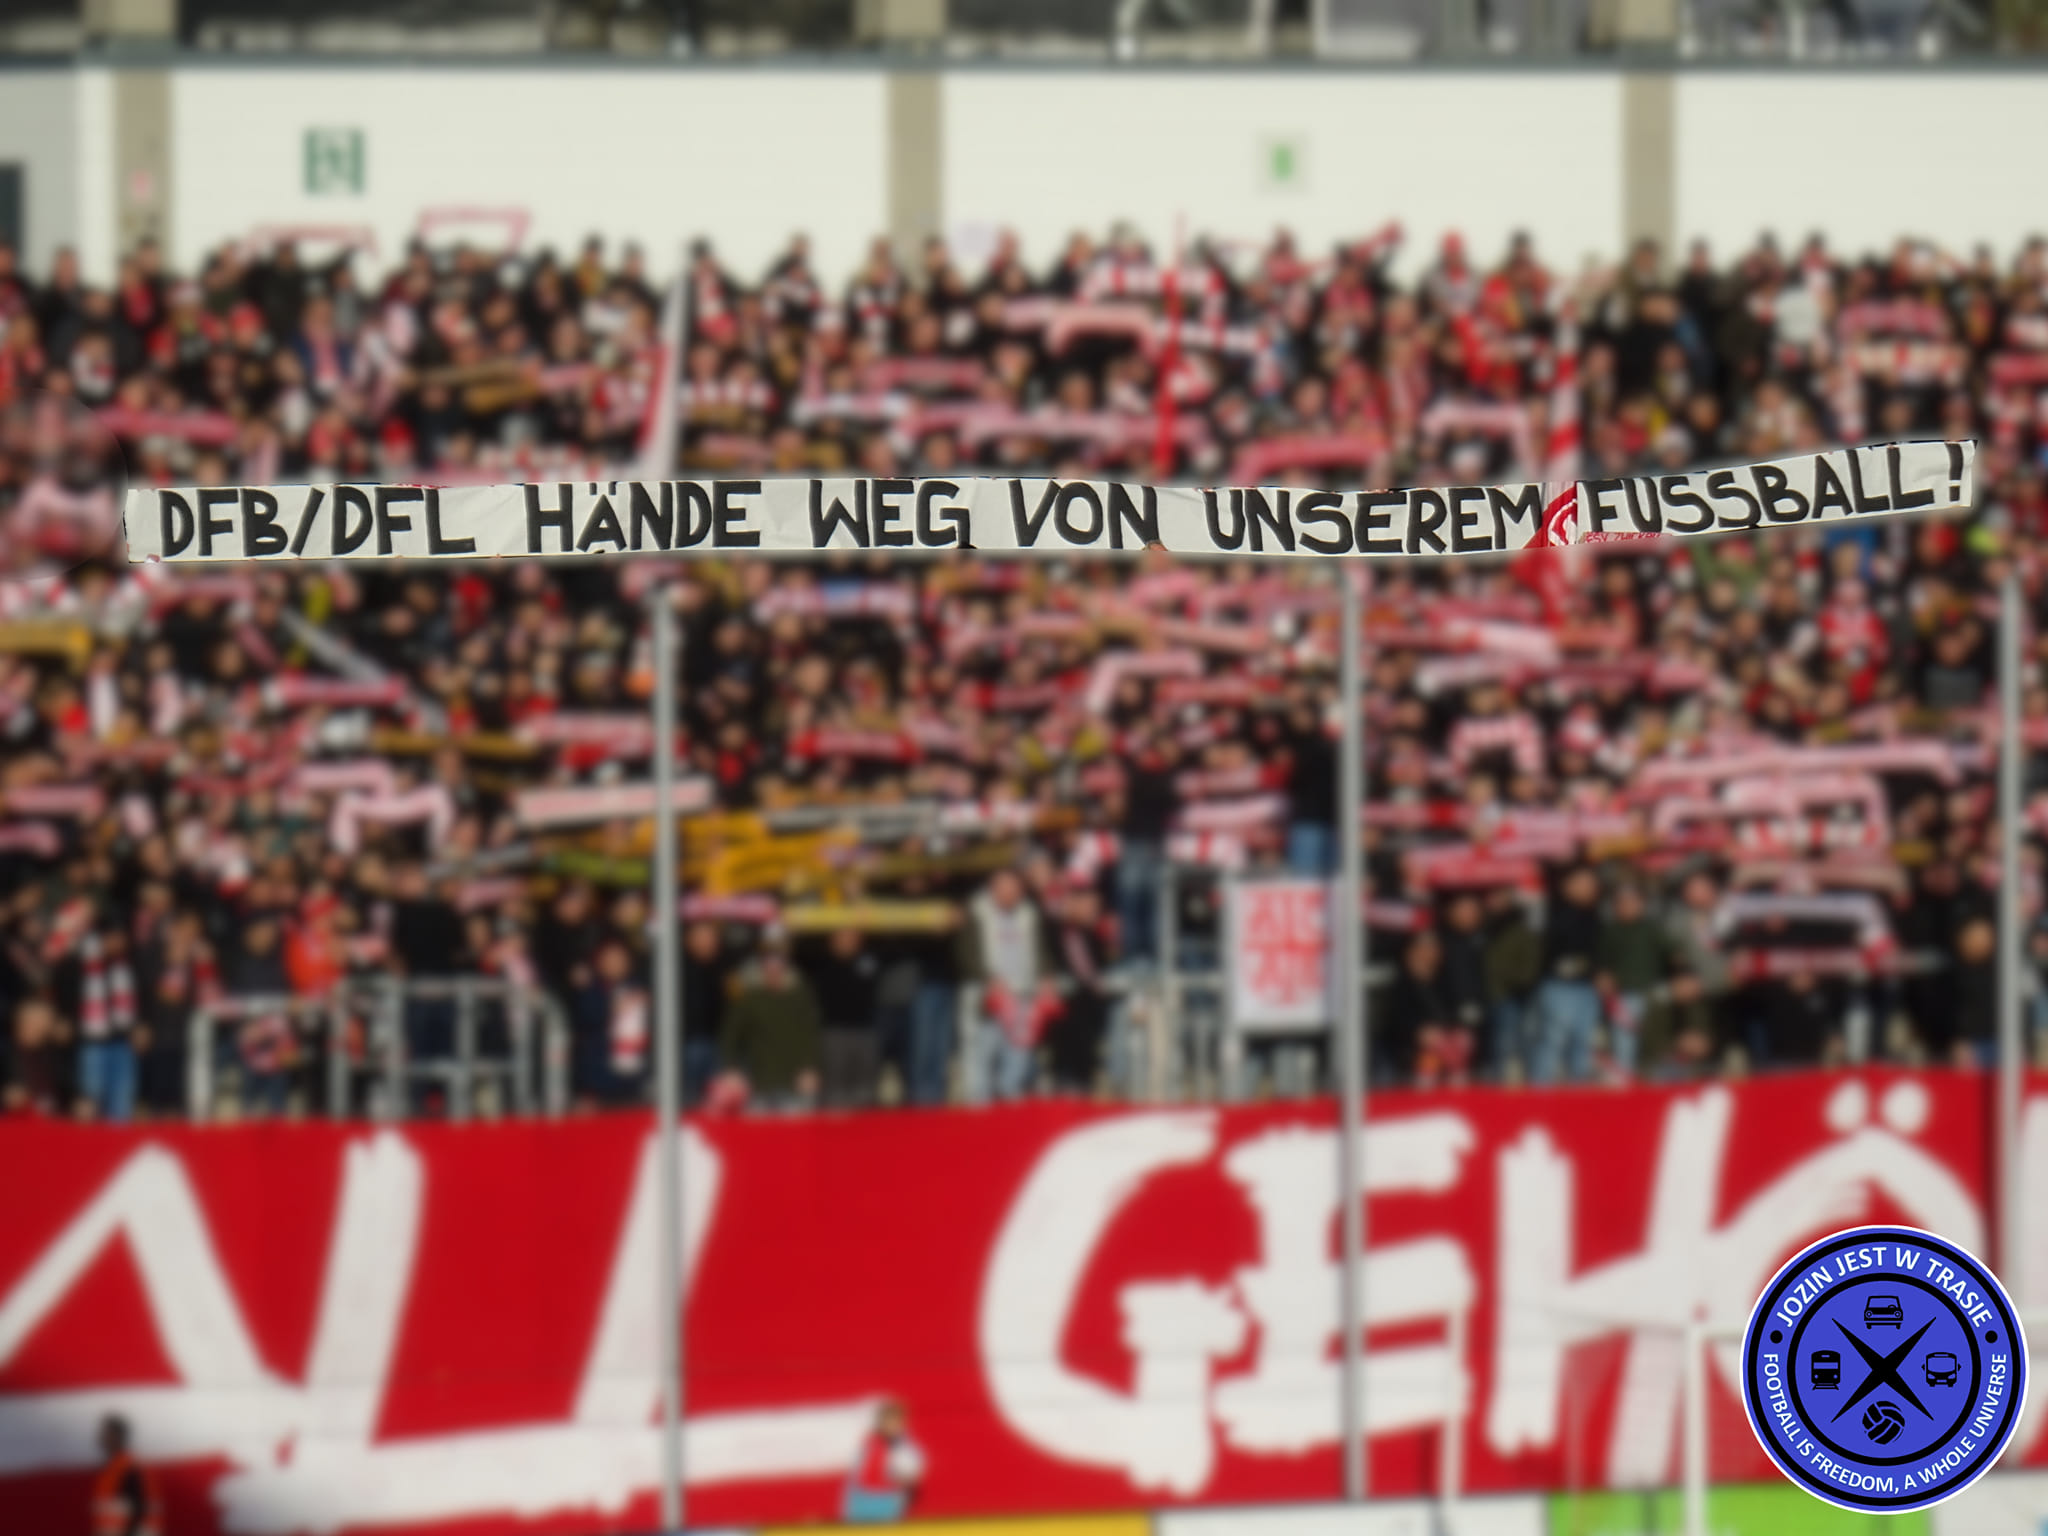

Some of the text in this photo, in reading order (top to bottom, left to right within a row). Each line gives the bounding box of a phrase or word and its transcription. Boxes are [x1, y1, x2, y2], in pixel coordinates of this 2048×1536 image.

[159, 486, 476, 557] DFB/DFL
[523, 480, 761, 553] HÄNDE
[808, 479, 973, 548] WEG
[1009, 479, 1160, 549] VON
[1203, 485, 1542, 554] UNSEREM
[980, 1078, 2048, 1497] GEHÖ
